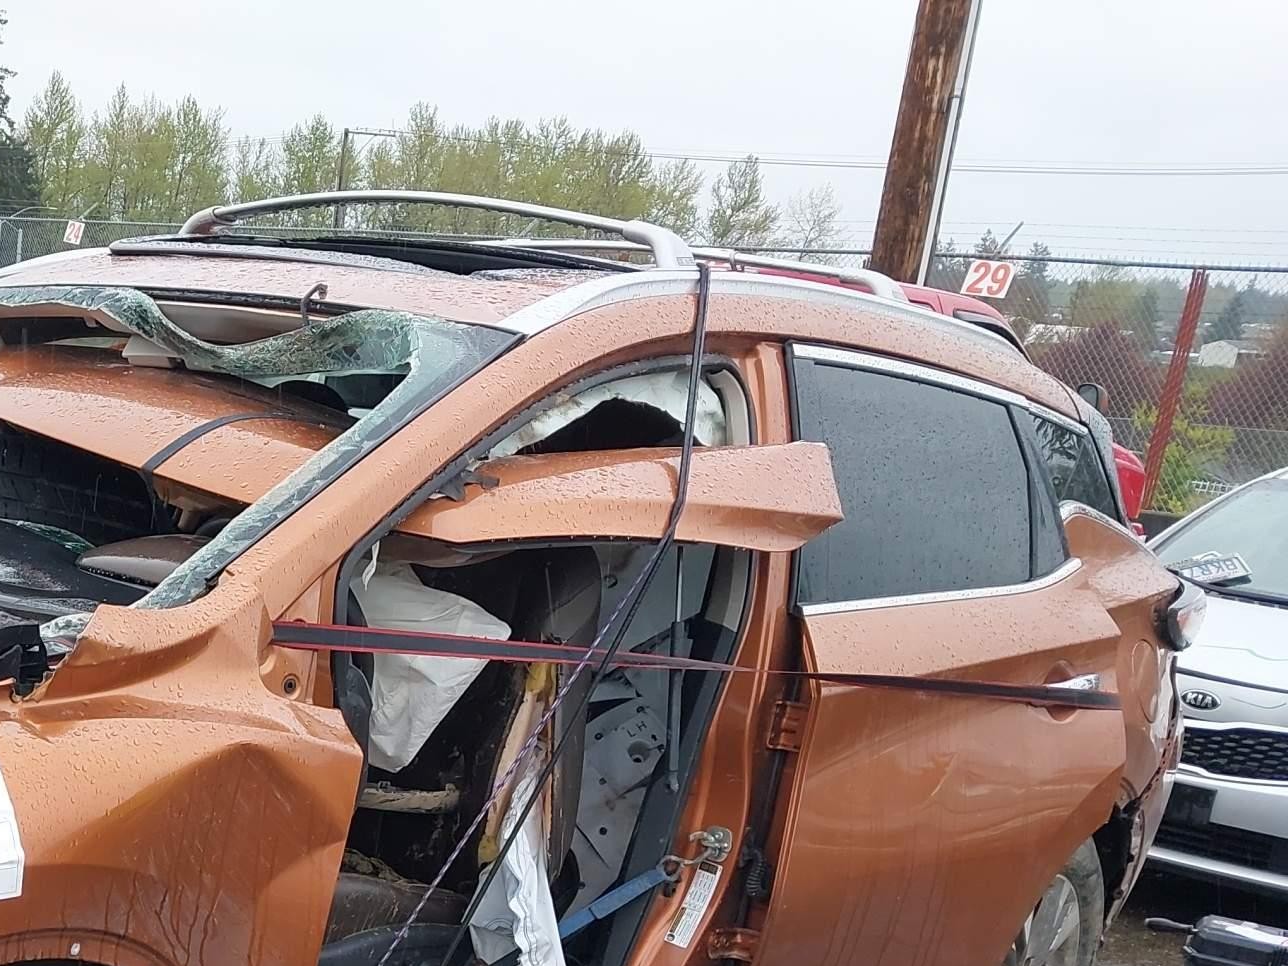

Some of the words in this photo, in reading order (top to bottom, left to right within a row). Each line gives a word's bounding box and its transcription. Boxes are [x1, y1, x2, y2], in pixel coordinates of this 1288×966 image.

[65, 221, 83, 243] 24
[965, 261, 1011, 296] 29
[1184, 691, 1213, 708] KIA
